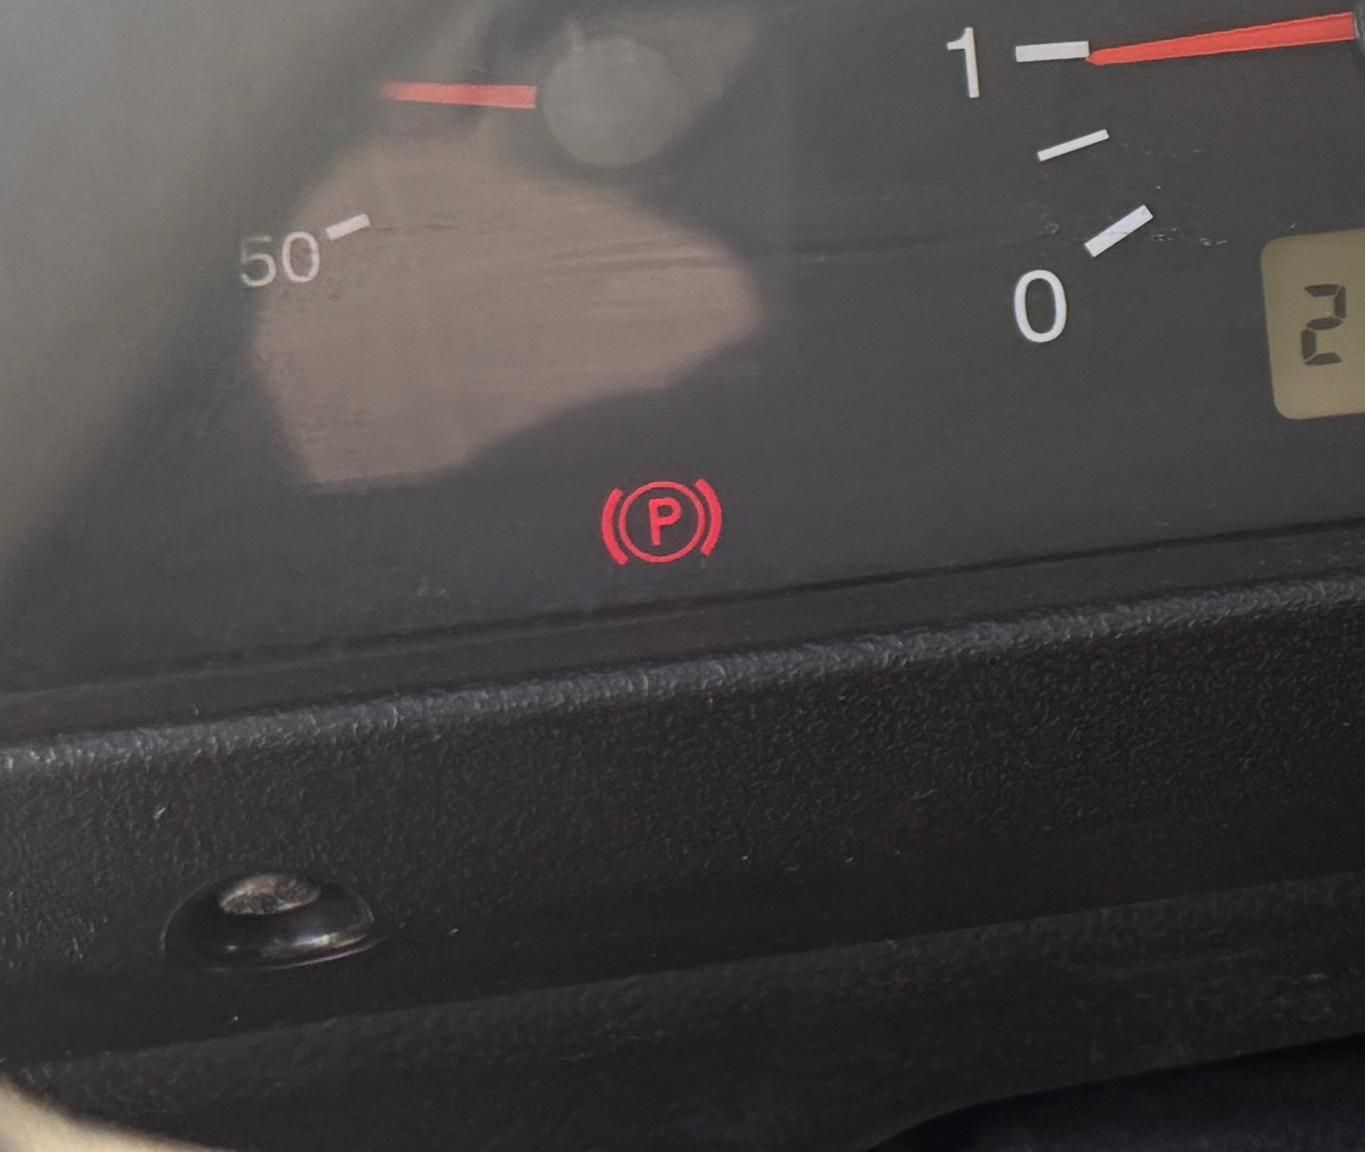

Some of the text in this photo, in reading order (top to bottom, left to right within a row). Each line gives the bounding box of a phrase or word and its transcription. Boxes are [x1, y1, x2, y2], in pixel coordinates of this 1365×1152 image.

[947, 26, 980, 99] 1
[239, 231, 321, 288] 50
[1013, 269, 1068, 343] 0
[647, 497, 681, 545] P
